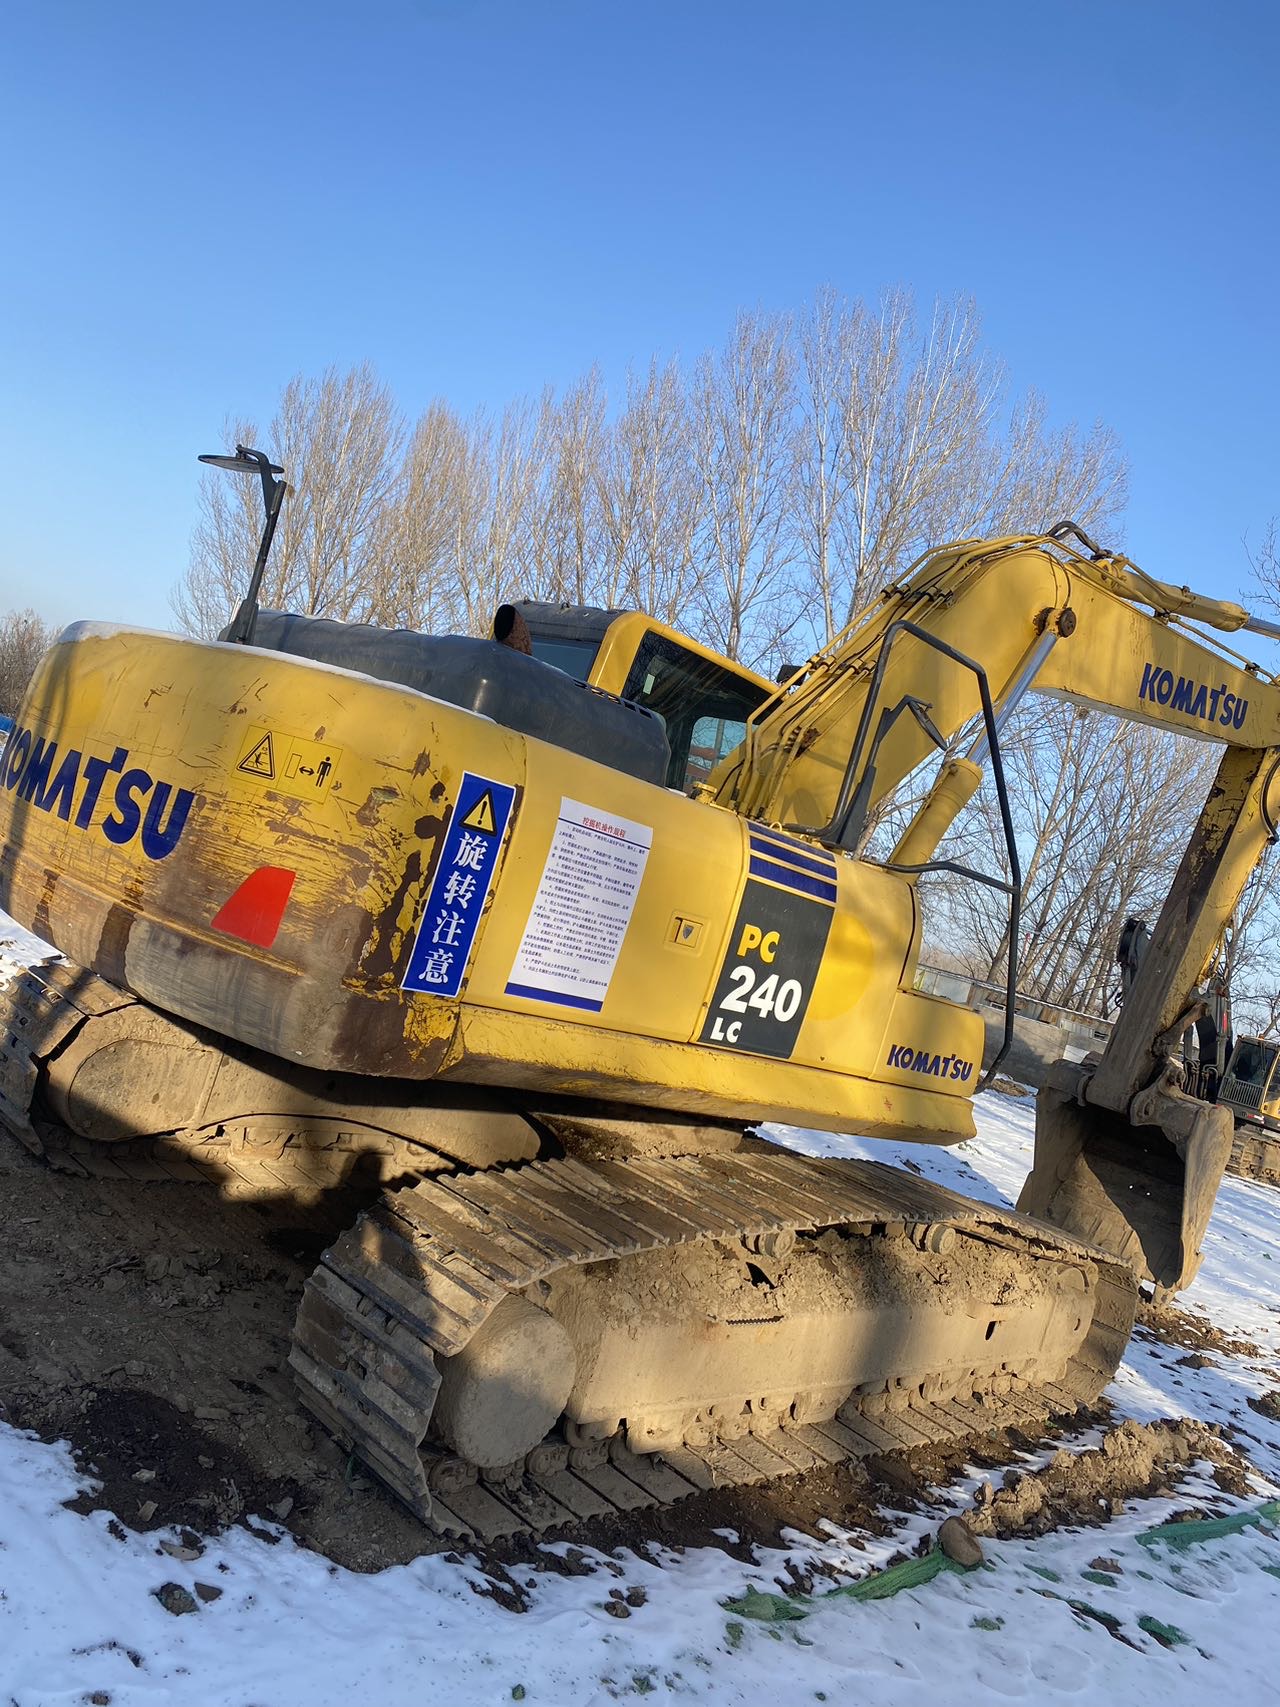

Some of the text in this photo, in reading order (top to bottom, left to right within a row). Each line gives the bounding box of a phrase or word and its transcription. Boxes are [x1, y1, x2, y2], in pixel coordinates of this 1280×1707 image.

[1138, 662, 1249, 730] KOMATSU
[0, 724, 196, 860] KOMATSU
[418, 831, 489, 984] 旋转注意
[737, 923, 781, 963] PC
[719, 965, 803, 1022] 240
[710, 1017, 742, 1043] LC
[886, 1044, 974, 1081] KOMATSU
